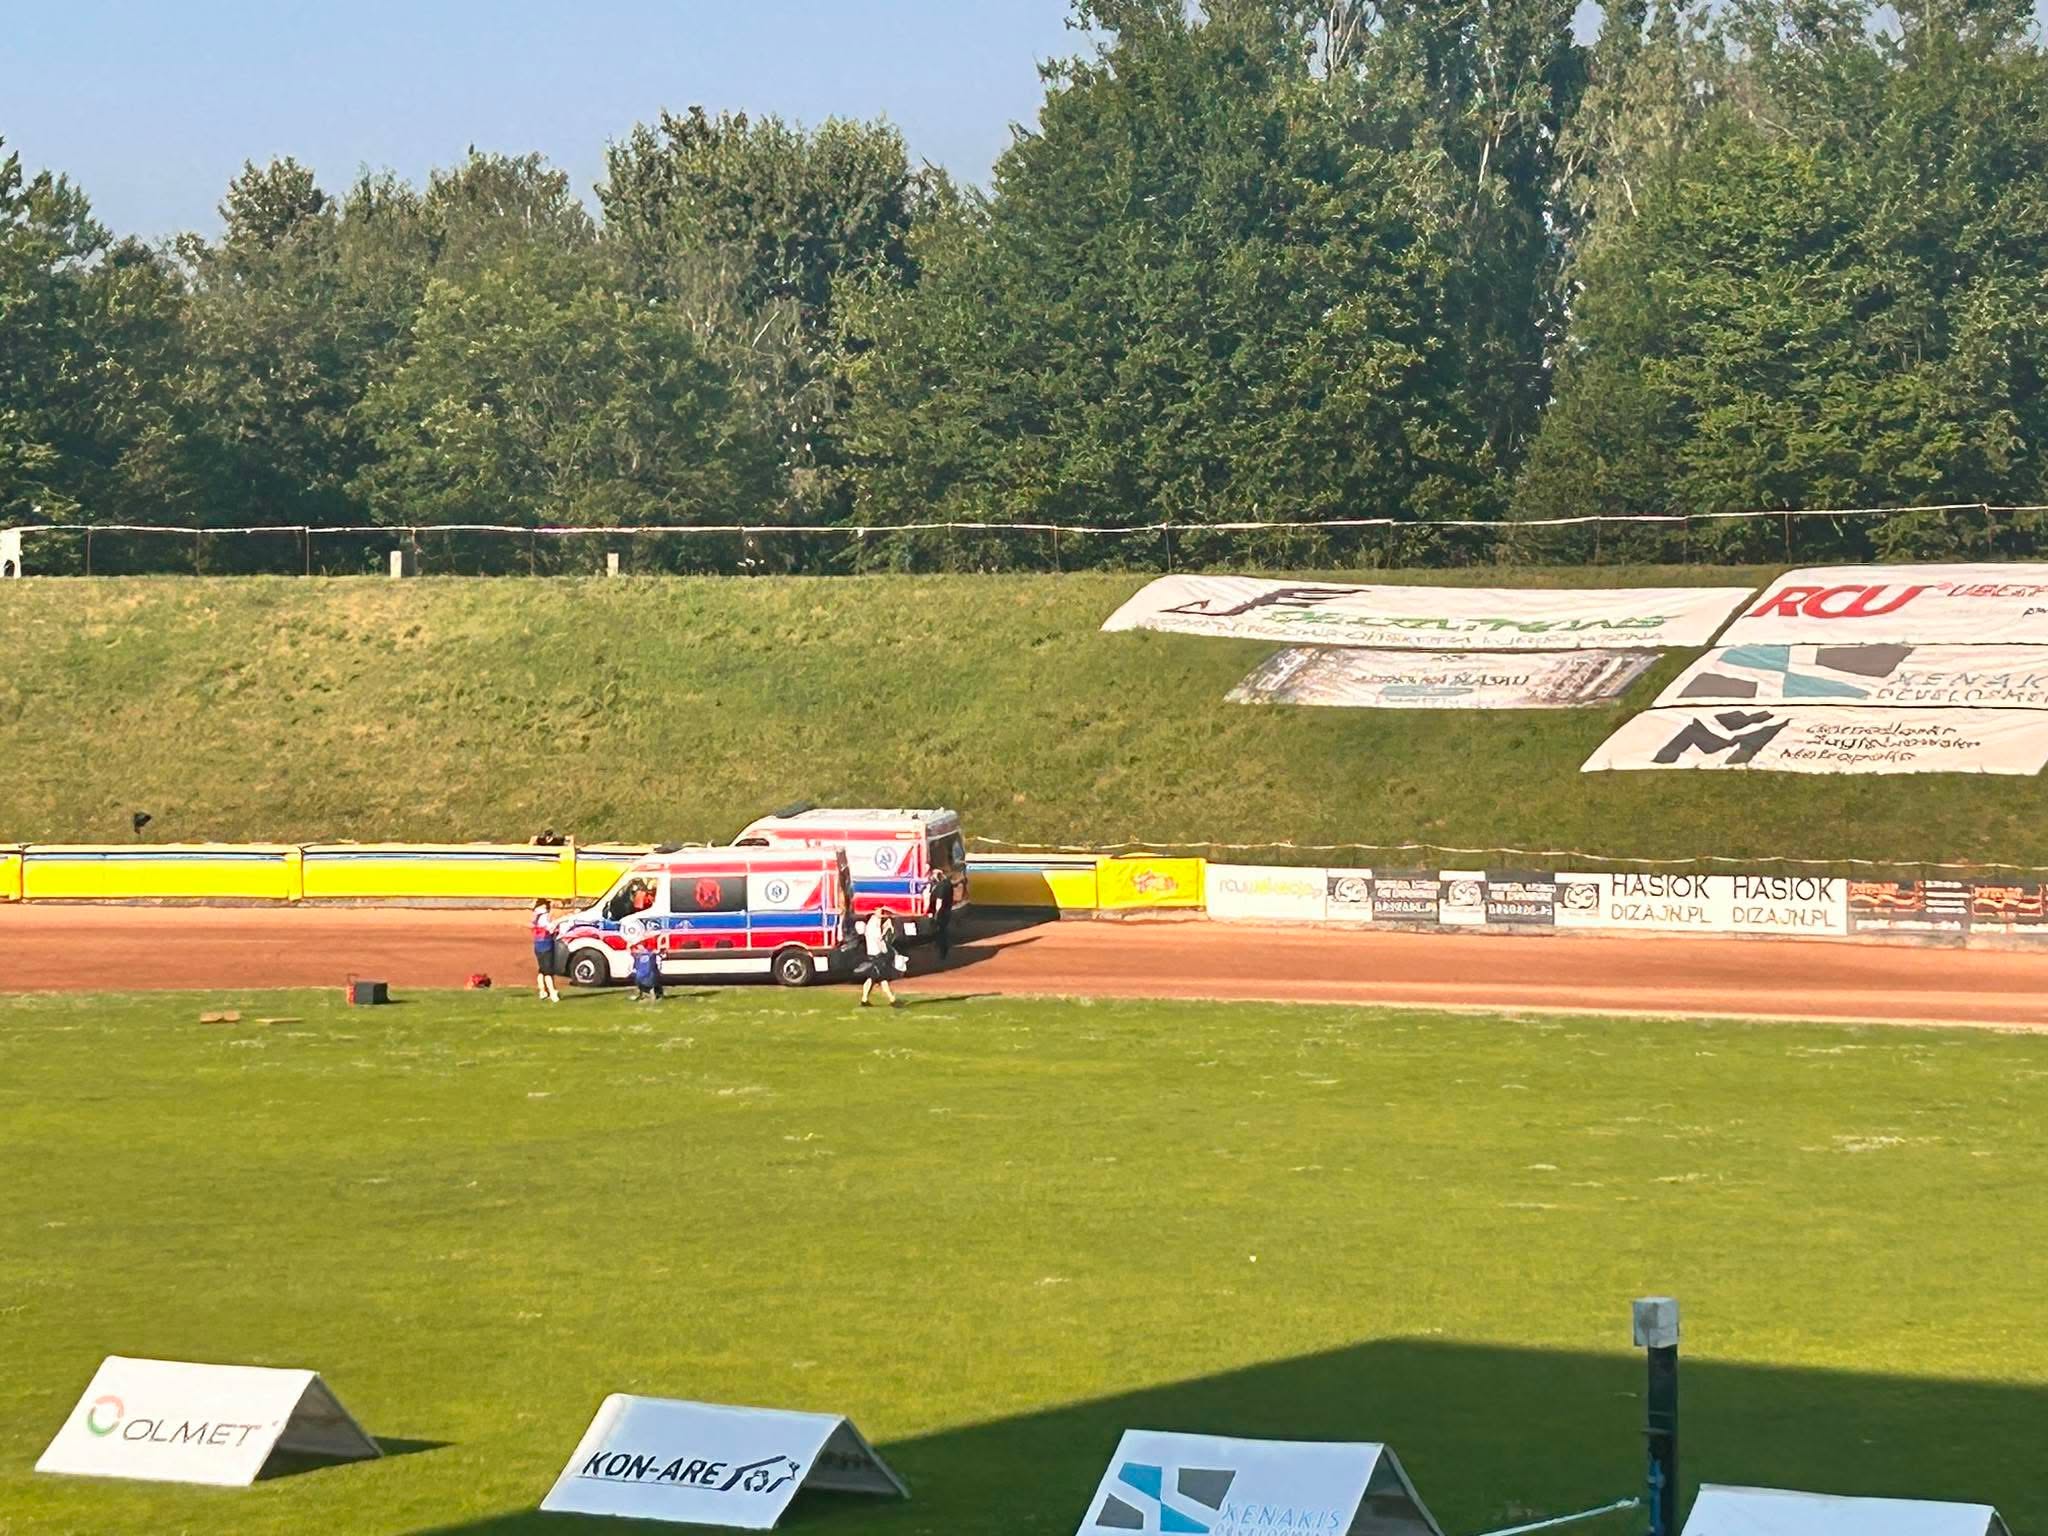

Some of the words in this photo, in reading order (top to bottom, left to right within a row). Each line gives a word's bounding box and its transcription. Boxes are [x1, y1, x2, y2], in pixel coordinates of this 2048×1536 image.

[1747, 584, 1937, 619] RCU
[1611, 873, 1710, 899] HASIOK
[1733, 875, 1836, 902] HASIOK
[1611, 903, 1712, 924] DIZAJN.PL
[1732, 906, 1838, 928] DIZAJN.PL
[122, 1418, 262, 1447] OLMET
